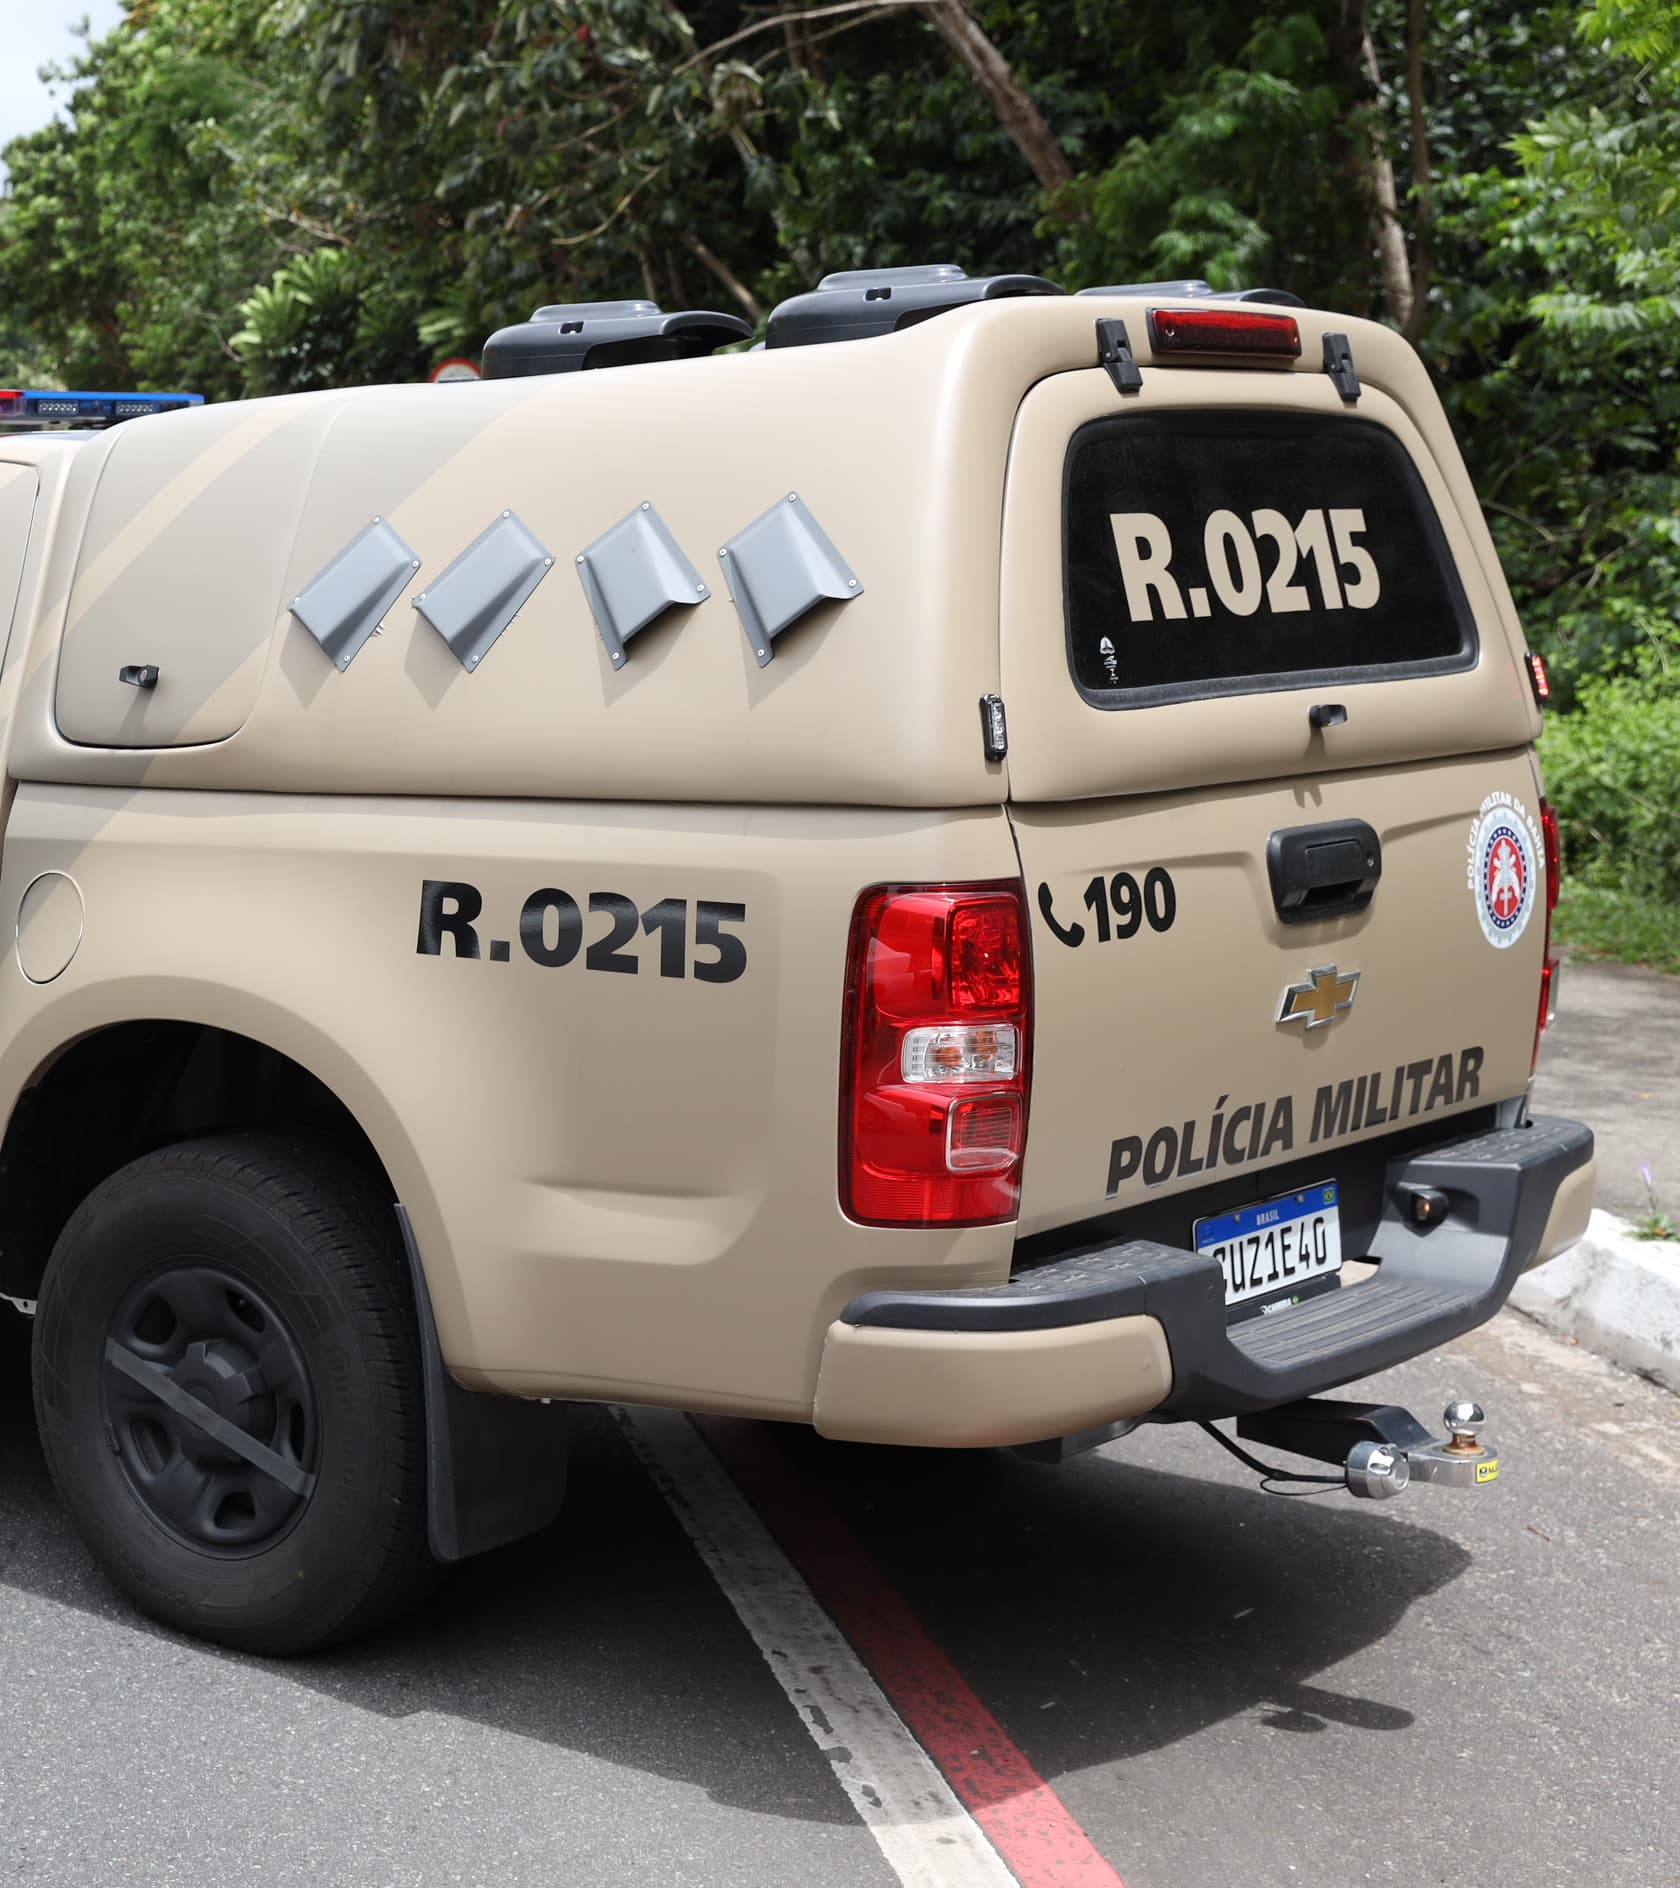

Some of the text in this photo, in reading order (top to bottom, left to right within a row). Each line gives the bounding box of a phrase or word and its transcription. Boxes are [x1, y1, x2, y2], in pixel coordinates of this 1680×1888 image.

[1109, 508, 1381, 622] R.0215
[1513, 797, 1526, 819] DA
[416, 880, 747, 984] R.0215
[1084, 866, 1177, 943] 190
[1104, 1046, 1485, 1201] POLÍCIA MILITAR
[1256, 1209, 1280, 1226] BRASIL
